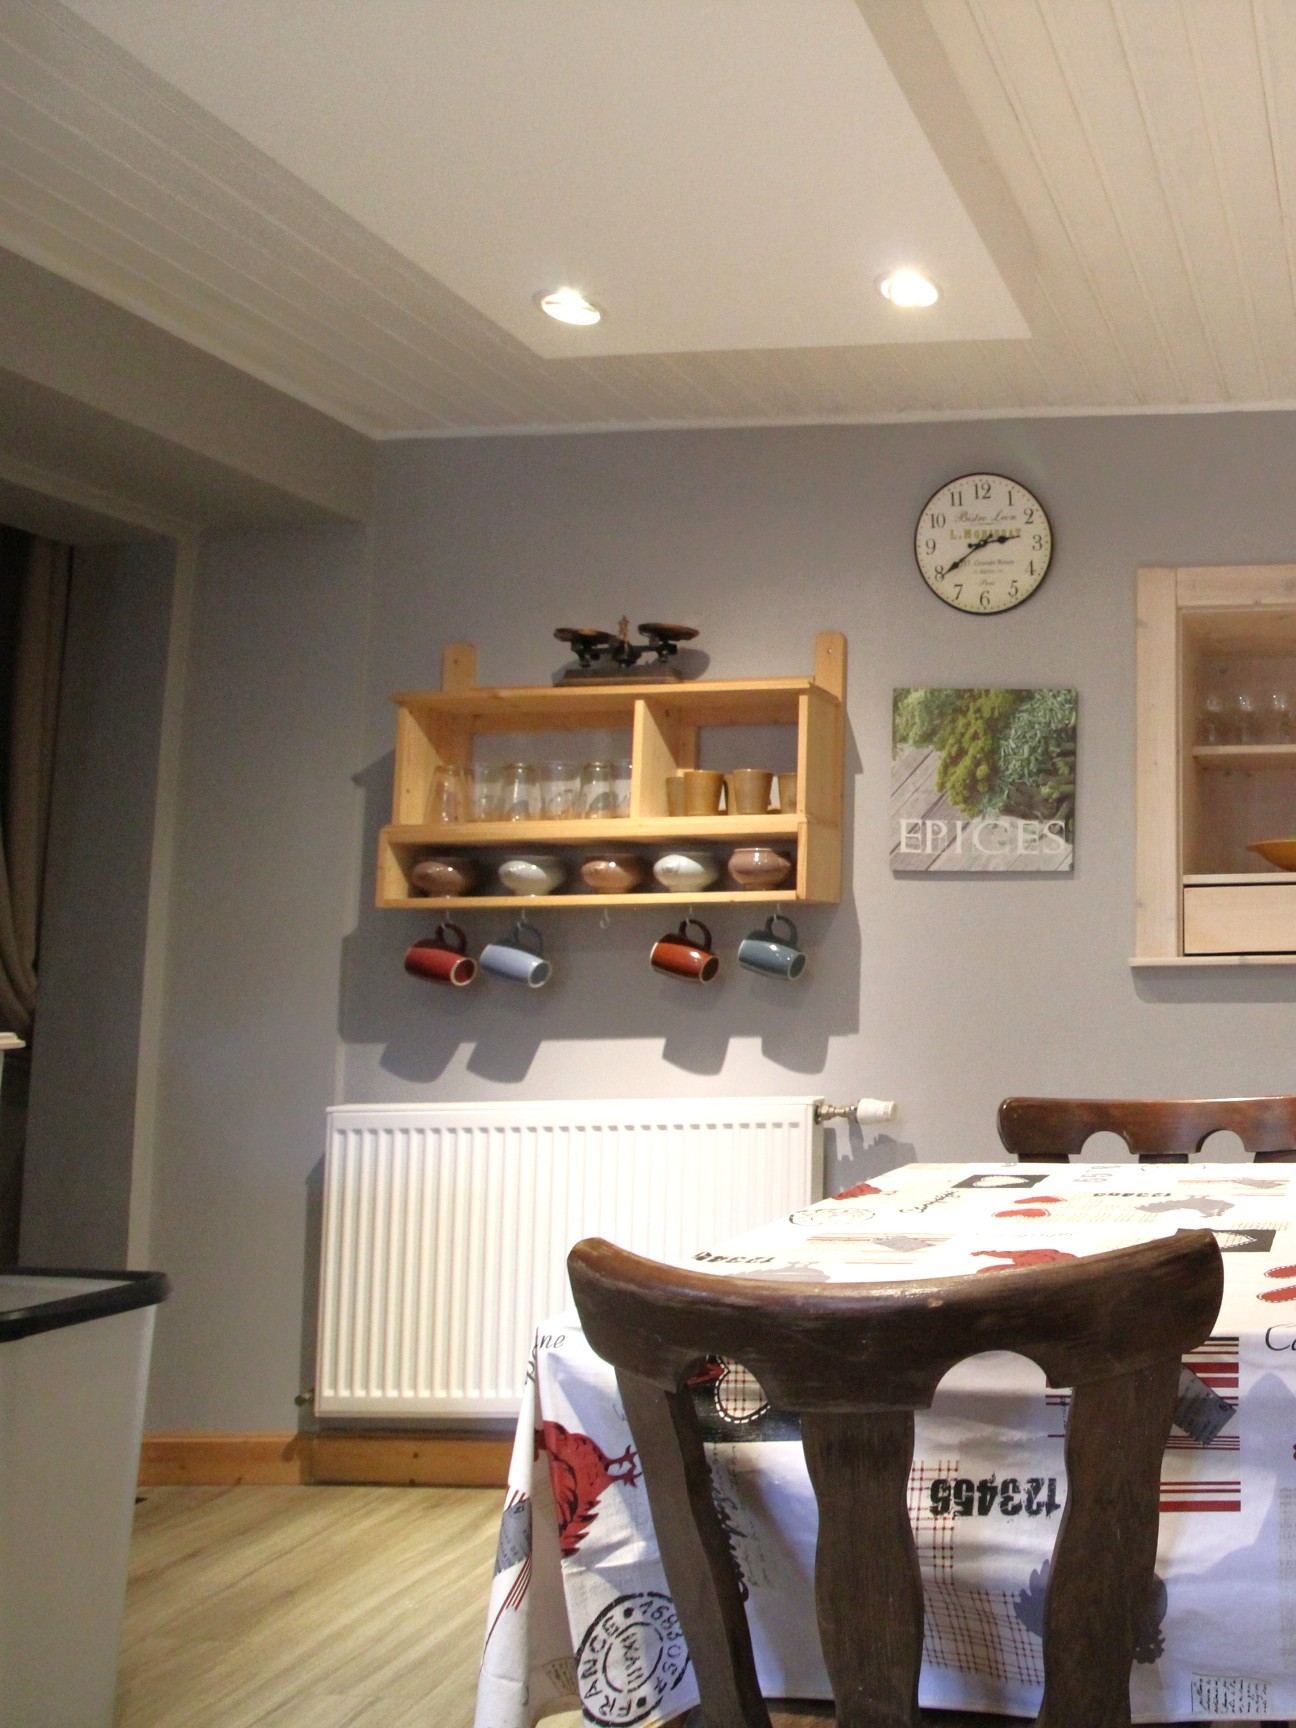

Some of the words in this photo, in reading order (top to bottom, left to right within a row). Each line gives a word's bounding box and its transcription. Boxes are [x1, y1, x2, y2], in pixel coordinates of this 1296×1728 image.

[951, 491, 964, 507] 11
[974, 482, 992, 500] 12
[1007, 490, 1013, 507] 1
[931, 513, 946, 529] 10
[1023, 507, 1035, 525] 2
[925, 538, 936, 556] 9
[1032, 534, 1043, 552] 3
[935, 565, 946, 582] 8
[1025, 559, 1036, 576] 4
[953, 583, 964, 601] 7
[1008, 579, 1019, 598] 5
[980, 590, 991, 607] 6
[899, 817, 1067, 855] EPICES
[929, 1471, 1061, 1518] 123456
[580, 1614, 633, 1718] FRANCE
